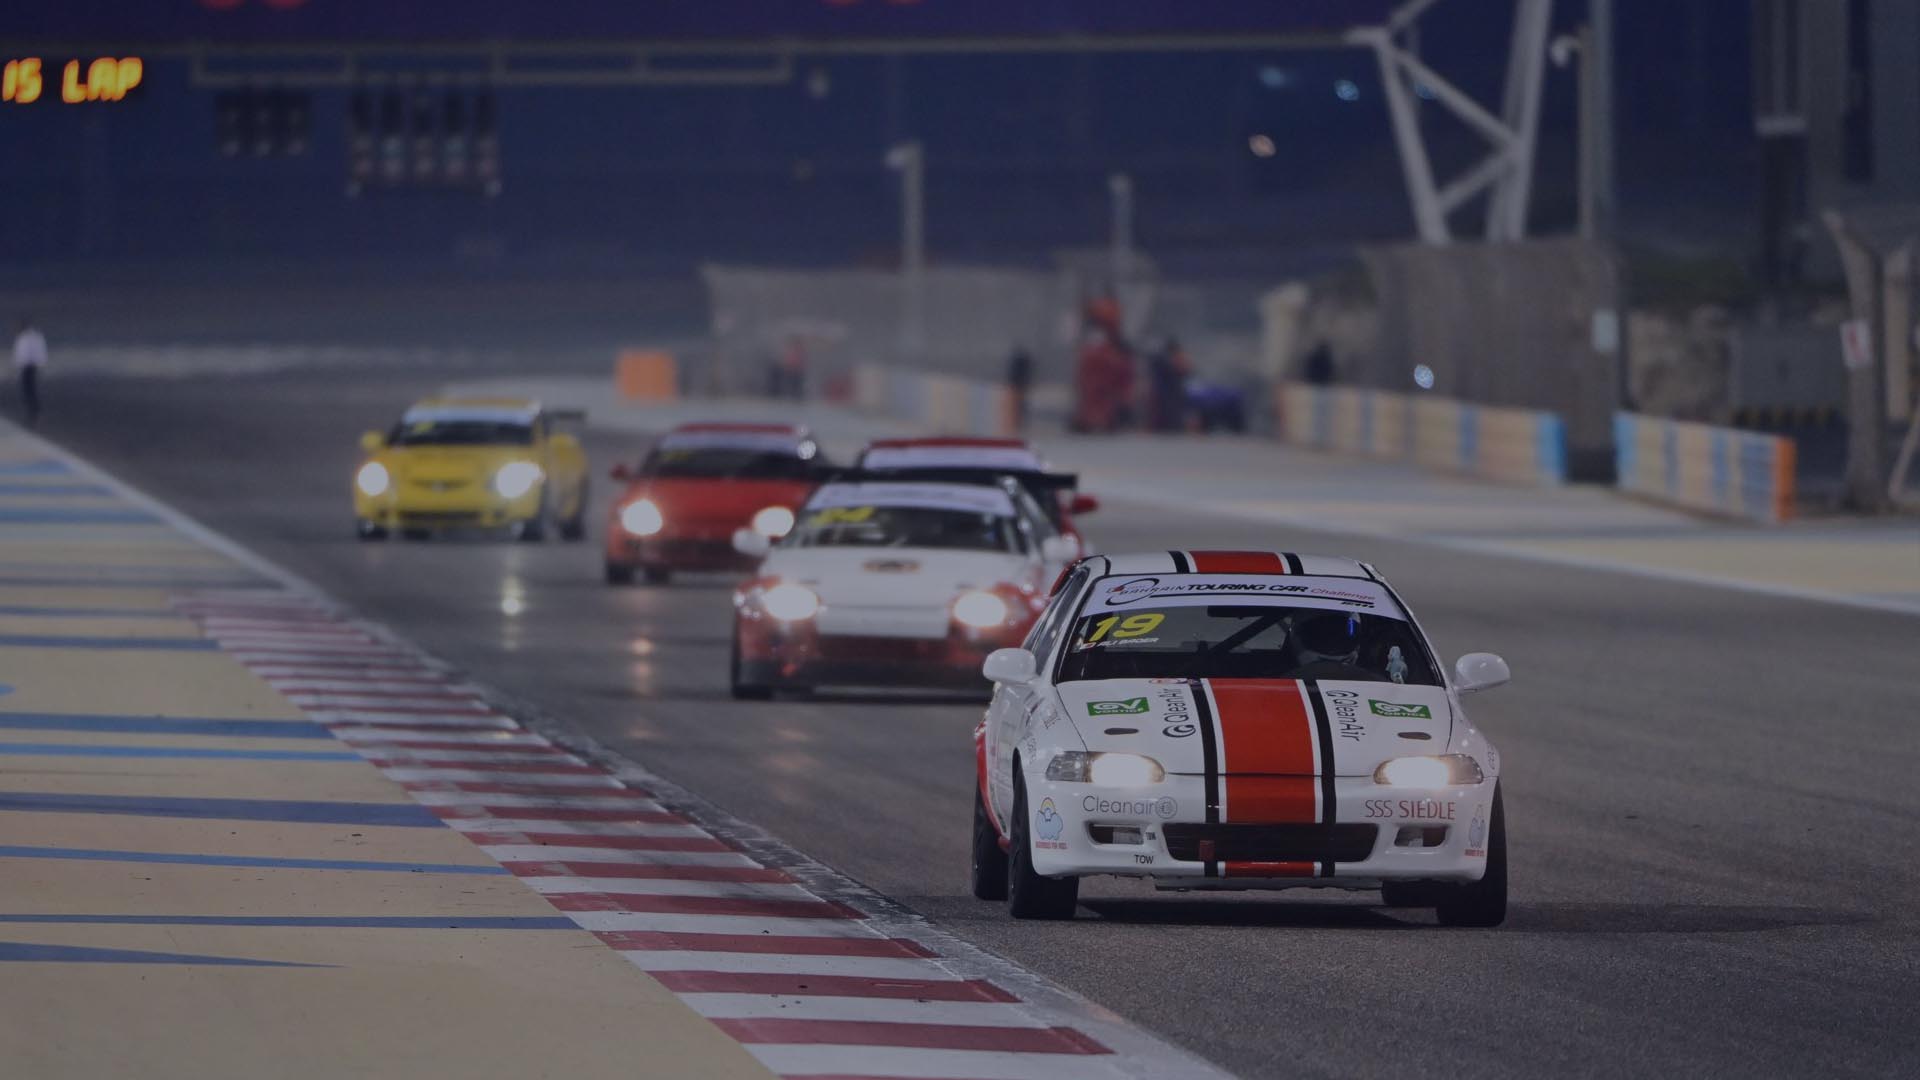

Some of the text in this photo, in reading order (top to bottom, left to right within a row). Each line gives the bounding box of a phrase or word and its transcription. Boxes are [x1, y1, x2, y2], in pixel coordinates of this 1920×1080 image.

[62, 56, 143, 104] LAP
[1188, 583, 1266, 593] TOURING
[1268, 584, 1309, 593] CAR
[1311, 587, 1376, 601] Challenge
[1088, 613, 1165, 643] 19
[1364, 799, 1456, 820] SSS SIEDLE
[1134, 853, 1154, 865] TOW
